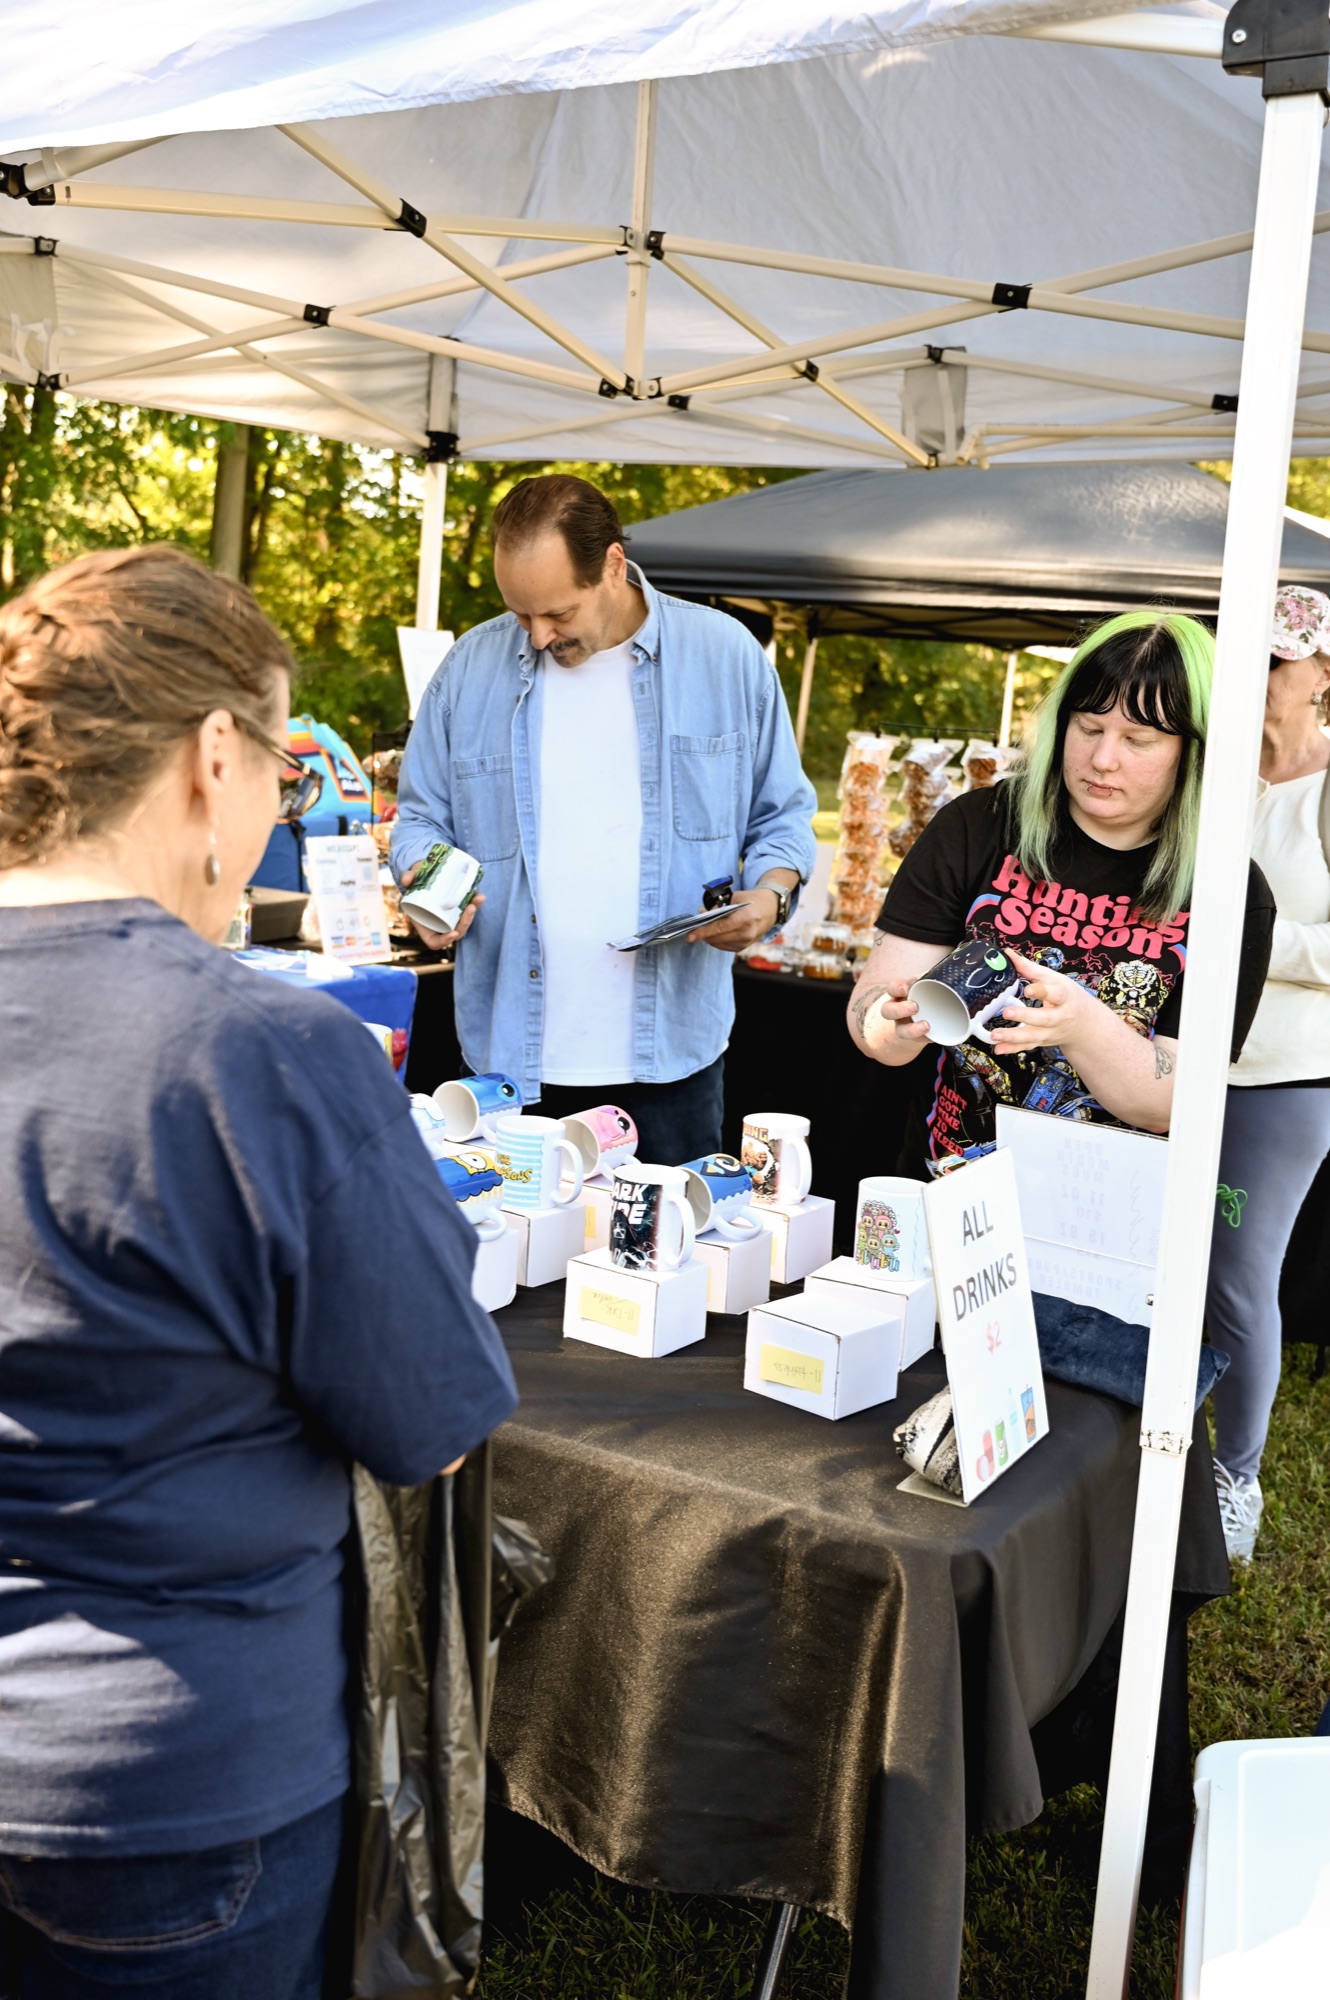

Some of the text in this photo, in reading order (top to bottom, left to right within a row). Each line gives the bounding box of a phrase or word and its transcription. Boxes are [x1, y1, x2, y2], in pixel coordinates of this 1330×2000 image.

[994, 897, 1163, 959] Season
[938, 1095, 960, 1117] GOT
[941, 1084, 967, 1110] AIN'T
[936, 1116, 948, 1133] TO
[937, 1106, 960, 1131] TIME
[932, 1126, 965, 1157] BLEED
[613, 1181, 649, 1202] ARK
[611, 1200, 648, 1225] IDE
[962, 1200, 994, 1246] ALL
[952, 1252, 1017, 1321] DRINKS
[986, 1321, 1002, 1354] $2
